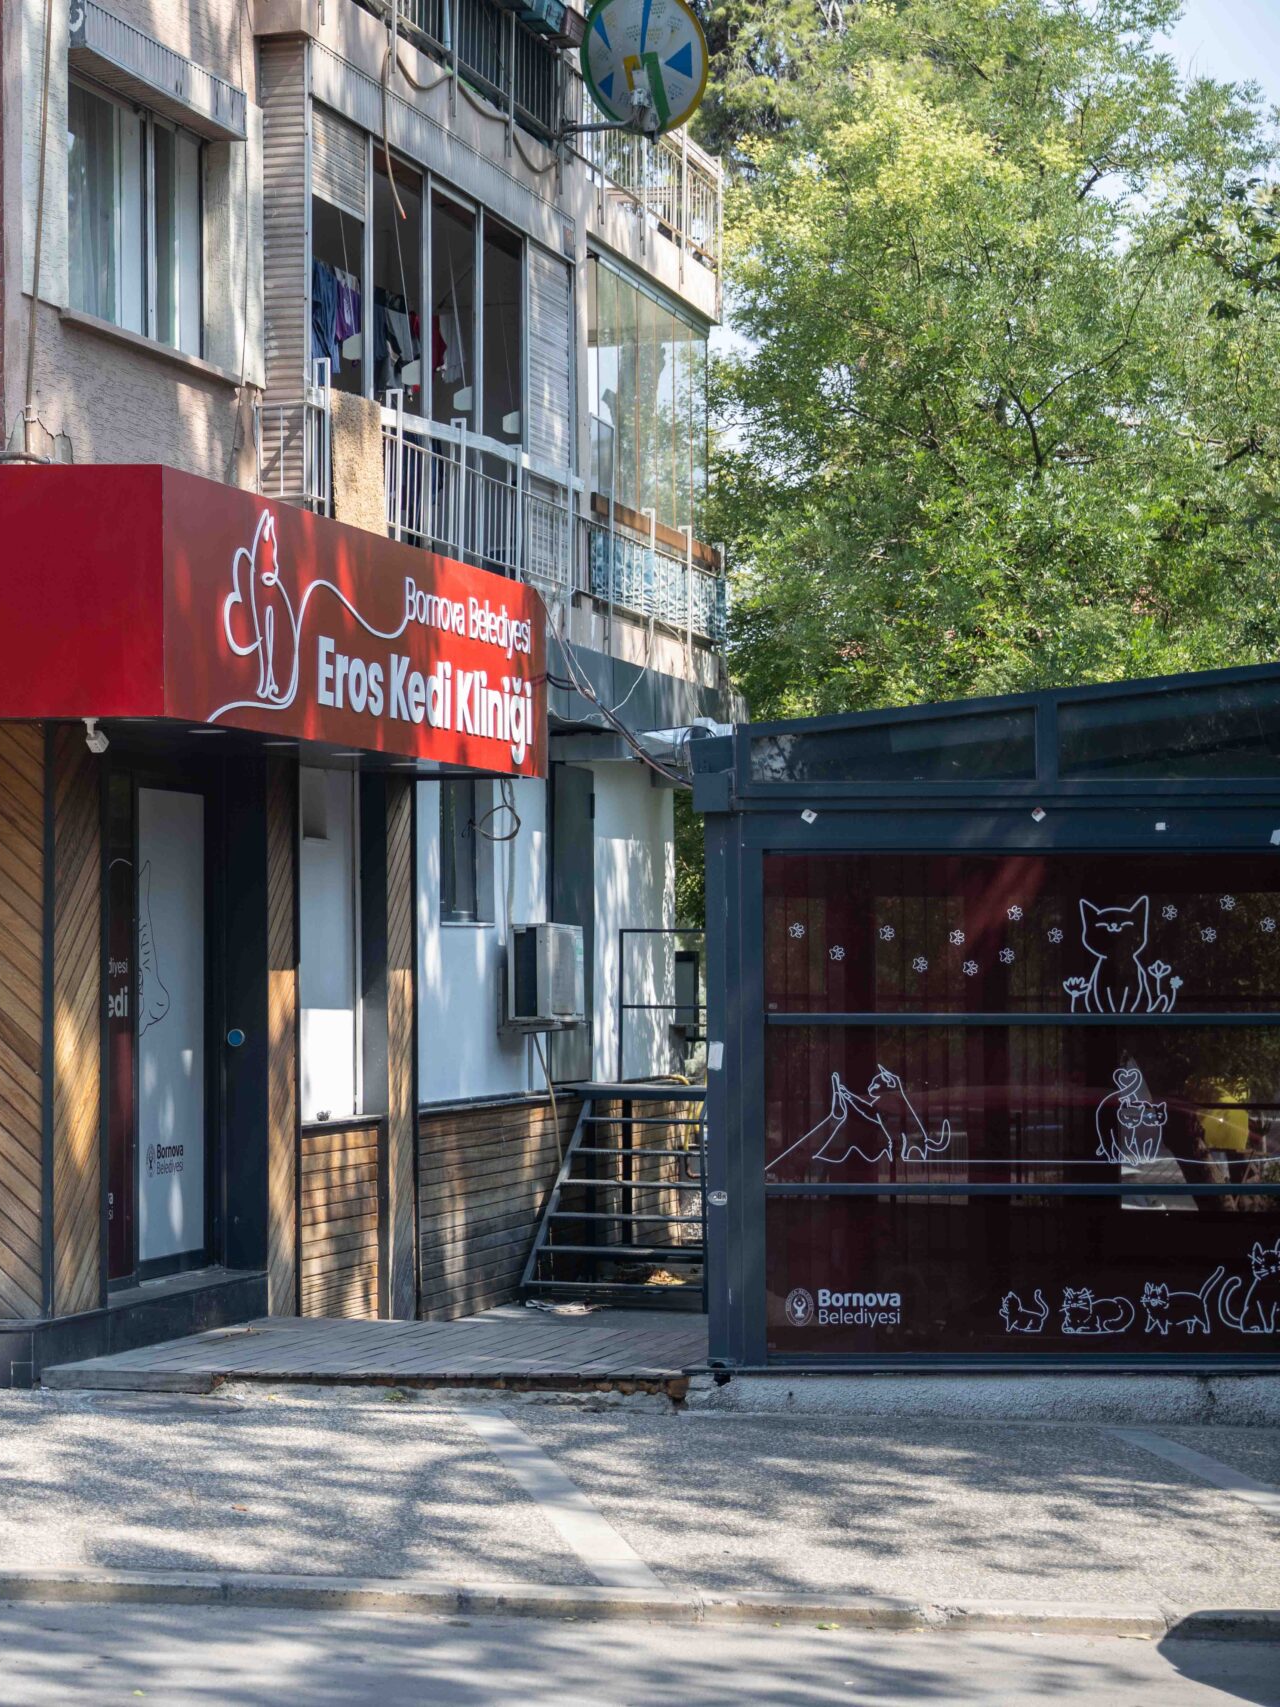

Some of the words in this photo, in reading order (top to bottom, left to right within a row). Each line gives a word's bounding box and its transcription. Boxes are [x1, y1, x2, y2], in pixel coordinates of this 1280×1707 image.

[405, 576, 465, 636] Bornova
[469, 597, 531, 659] Belediyesi
[317, 635, 384, 717] Eros
[390, 653, 452, 730] Kedi
[456, 669, 532, 765] Kliniği
[156, 1144, 184, 1159] Bornova
[156, 1158, 184, 1175] Belediyesi
[817, 1288, 901, 1307] Bornova
[818, 1308, 901, 1328] Belediyesi
